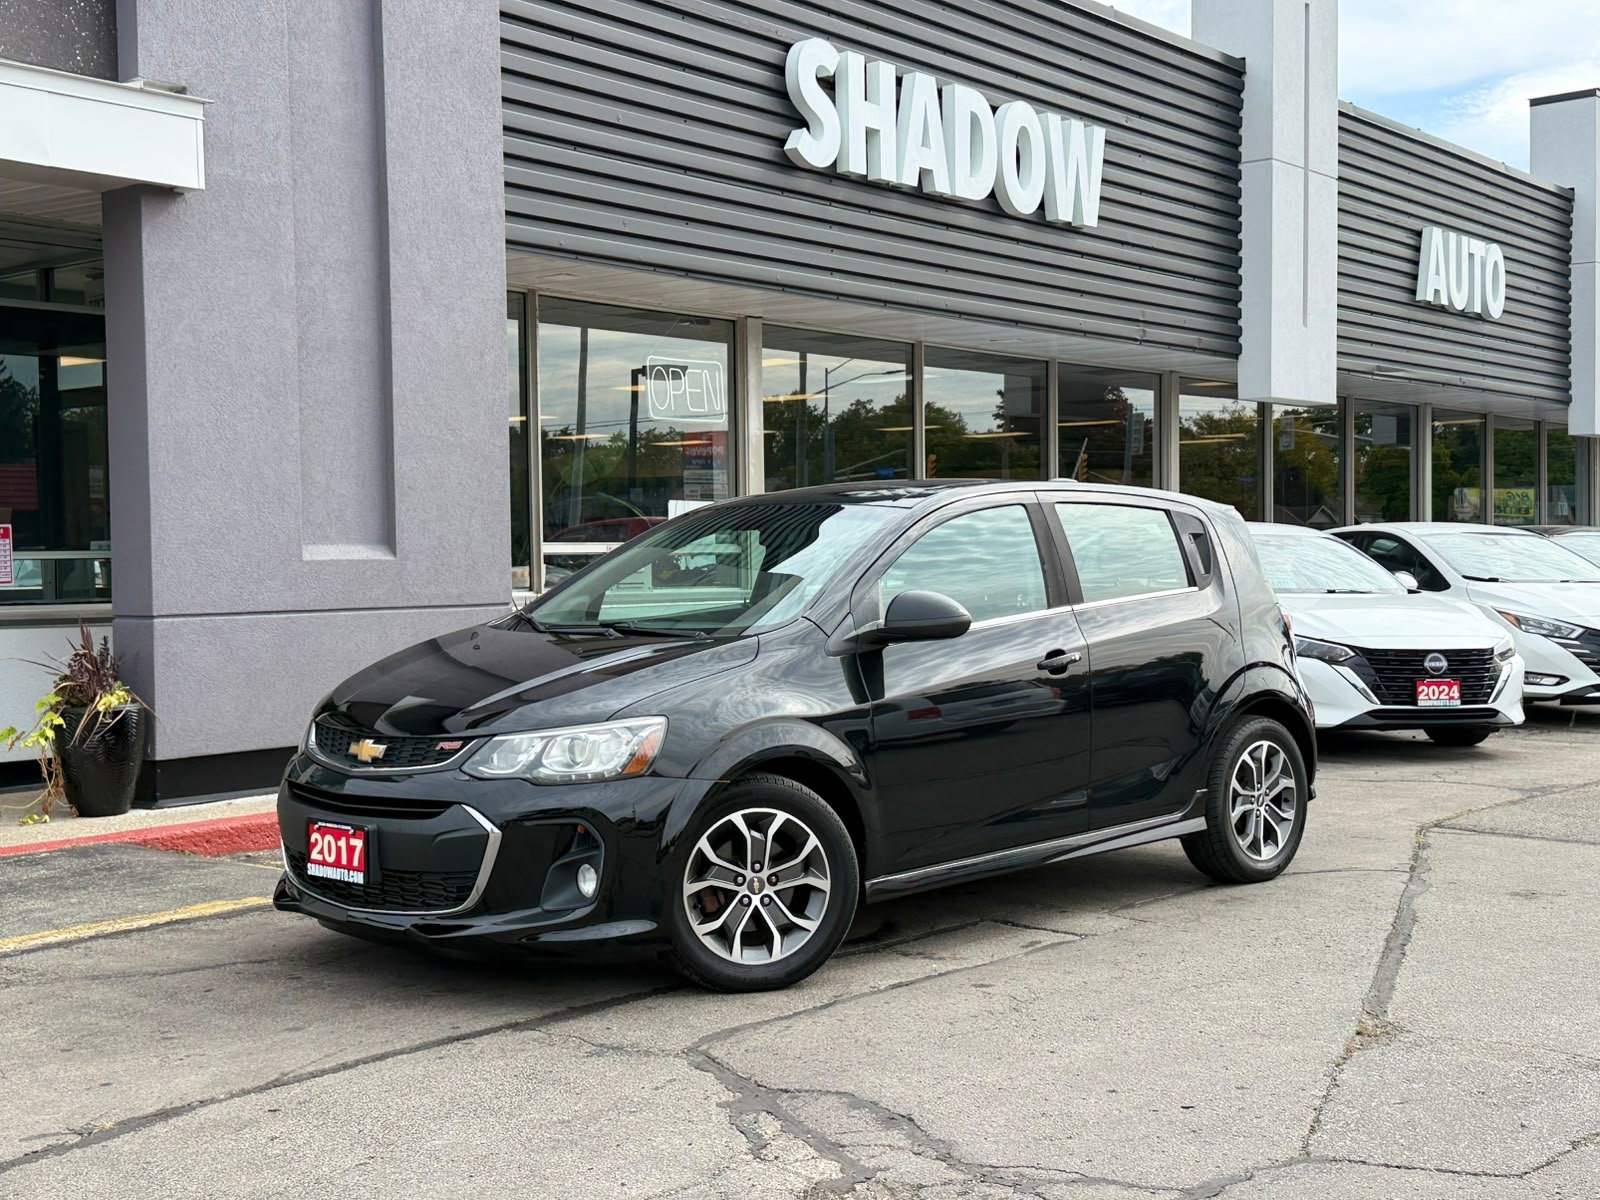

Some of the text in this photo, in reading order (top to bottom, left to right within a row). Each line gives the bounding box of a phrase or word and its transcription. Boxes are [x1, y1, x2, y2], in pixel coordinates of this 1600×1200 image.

[785, 37, 1106, 228] SHADOW
[1416, 226, 1506, 319] AUTO
[651, 366, 721, 412] OPEN
[1418, 685, 1460, 700] 2024
[435, 741, 464, 750] RS
[310, 832, 363, 867] 2017
[307, 862, 364, 885] SHADOWAUTO.COM
